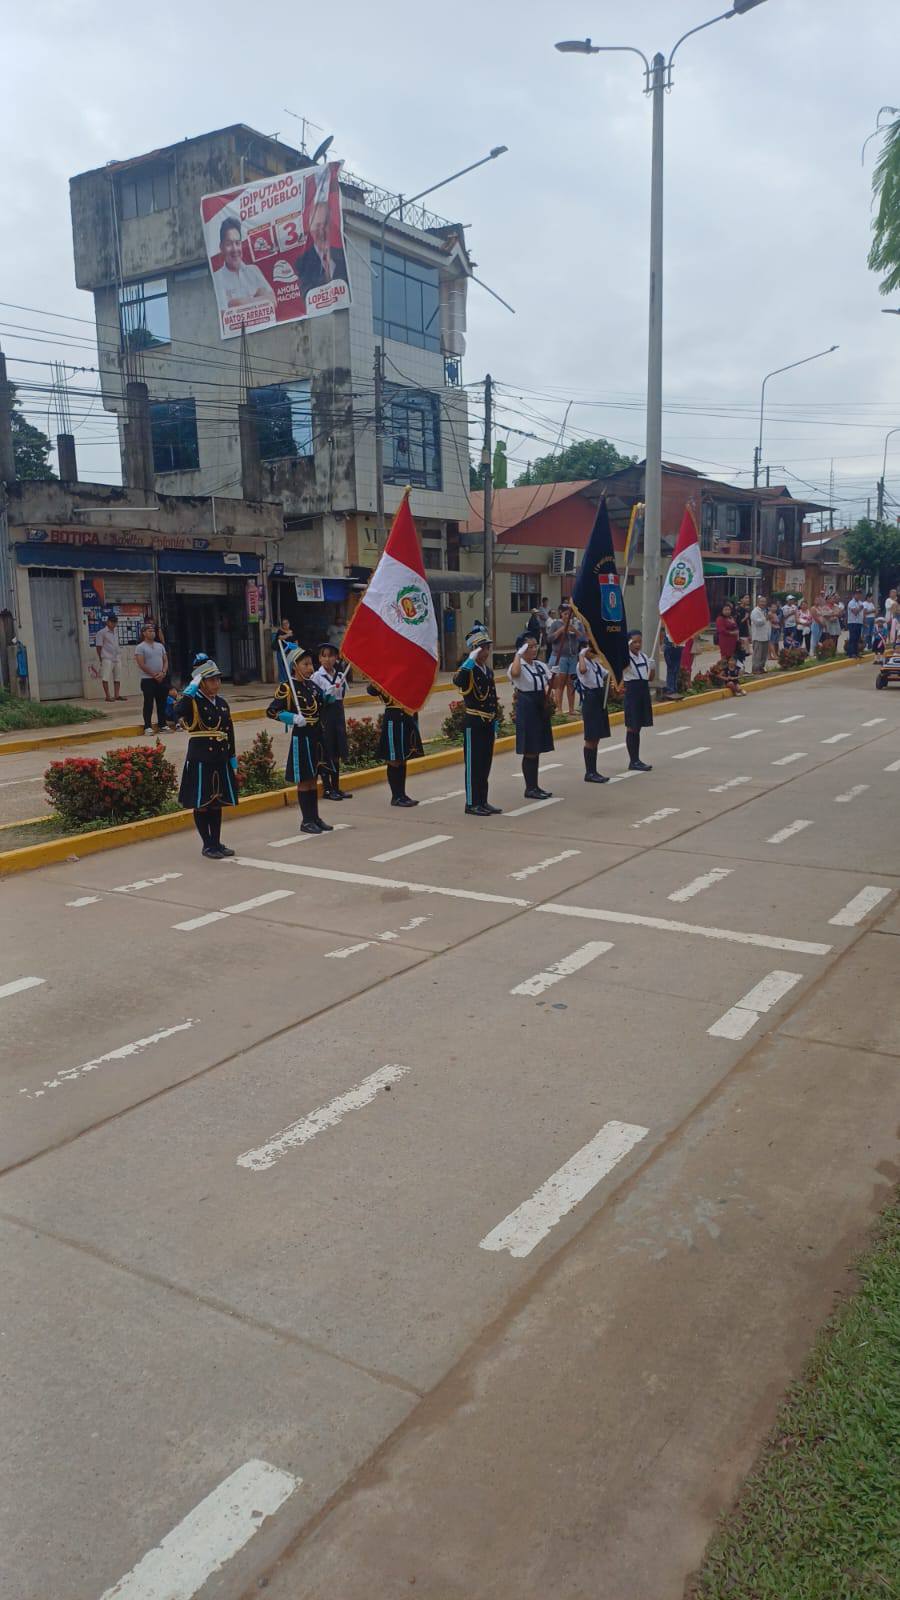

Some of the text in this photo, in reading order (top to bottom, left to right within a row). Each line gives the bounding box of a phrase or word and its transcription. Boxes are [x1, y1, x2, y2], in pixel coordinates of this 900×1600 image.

[240, 176, 293, 209] ¡DIPUTADO
[240, 206, 259, 222] DEL
[261, 183, 302, 213] PUEBLO!
[283, 222, 299, 247] 3
[51, 529, 100, 545] BOTICA
